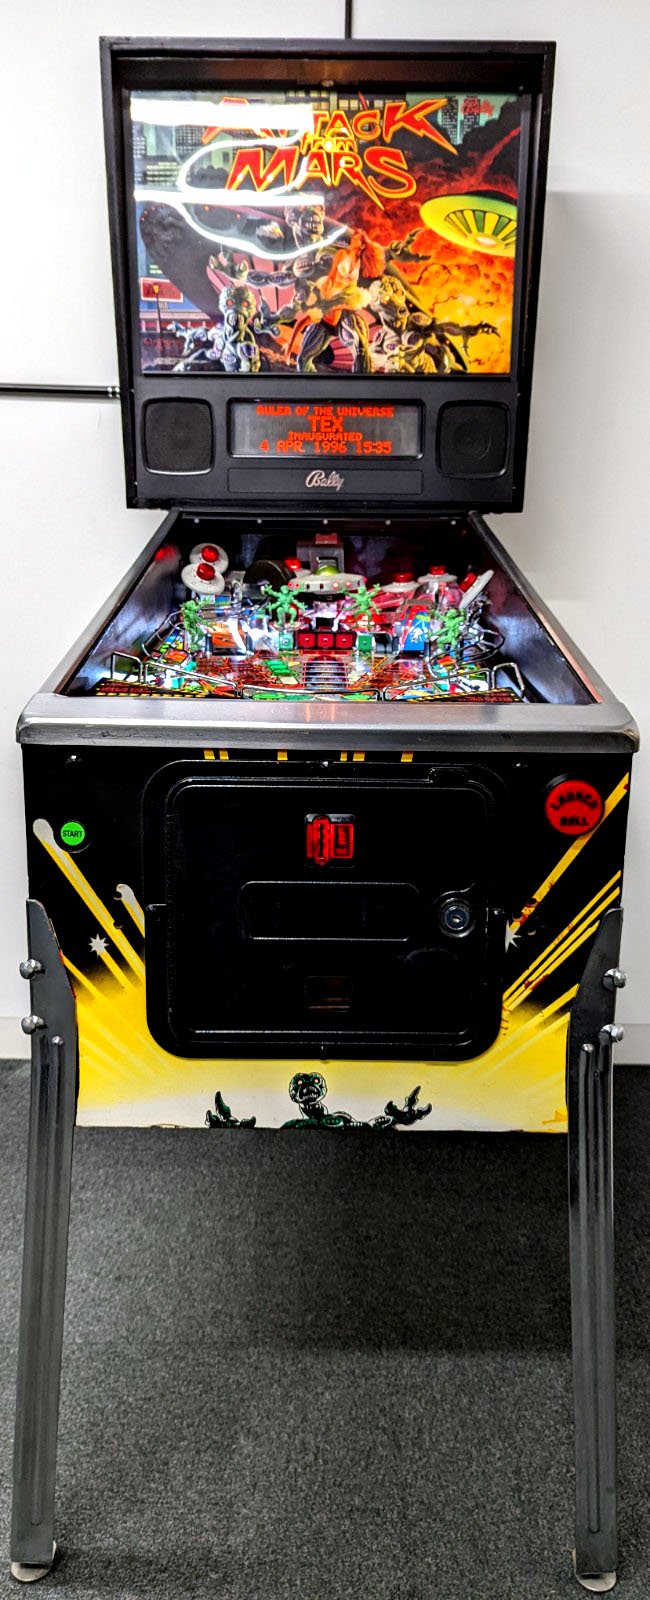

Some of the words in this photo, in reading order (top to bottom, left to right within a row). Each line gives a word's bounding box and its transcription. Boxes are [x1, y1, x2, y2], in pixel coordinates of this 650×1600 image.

[201, 96, 458, 156] TACK
[225, 146, 417, 211] MARS
[256, 405, 292, 416] RULER
[294, 405, 309, 416] OF
[313, 406, 334, 417] THE
[337, 406, 394, 417] UNIVERSE
[307, 415, 344, 432] TEX
[288, 431, 363, 442] INAUGURATED
[259, 439, 269, 452] 4
[314, 440, 348, 453] 1996
[356, 441, 393, 454] 15:35
[305, 470, 344, 491] Bally
[62, 829, 83, 838] START
